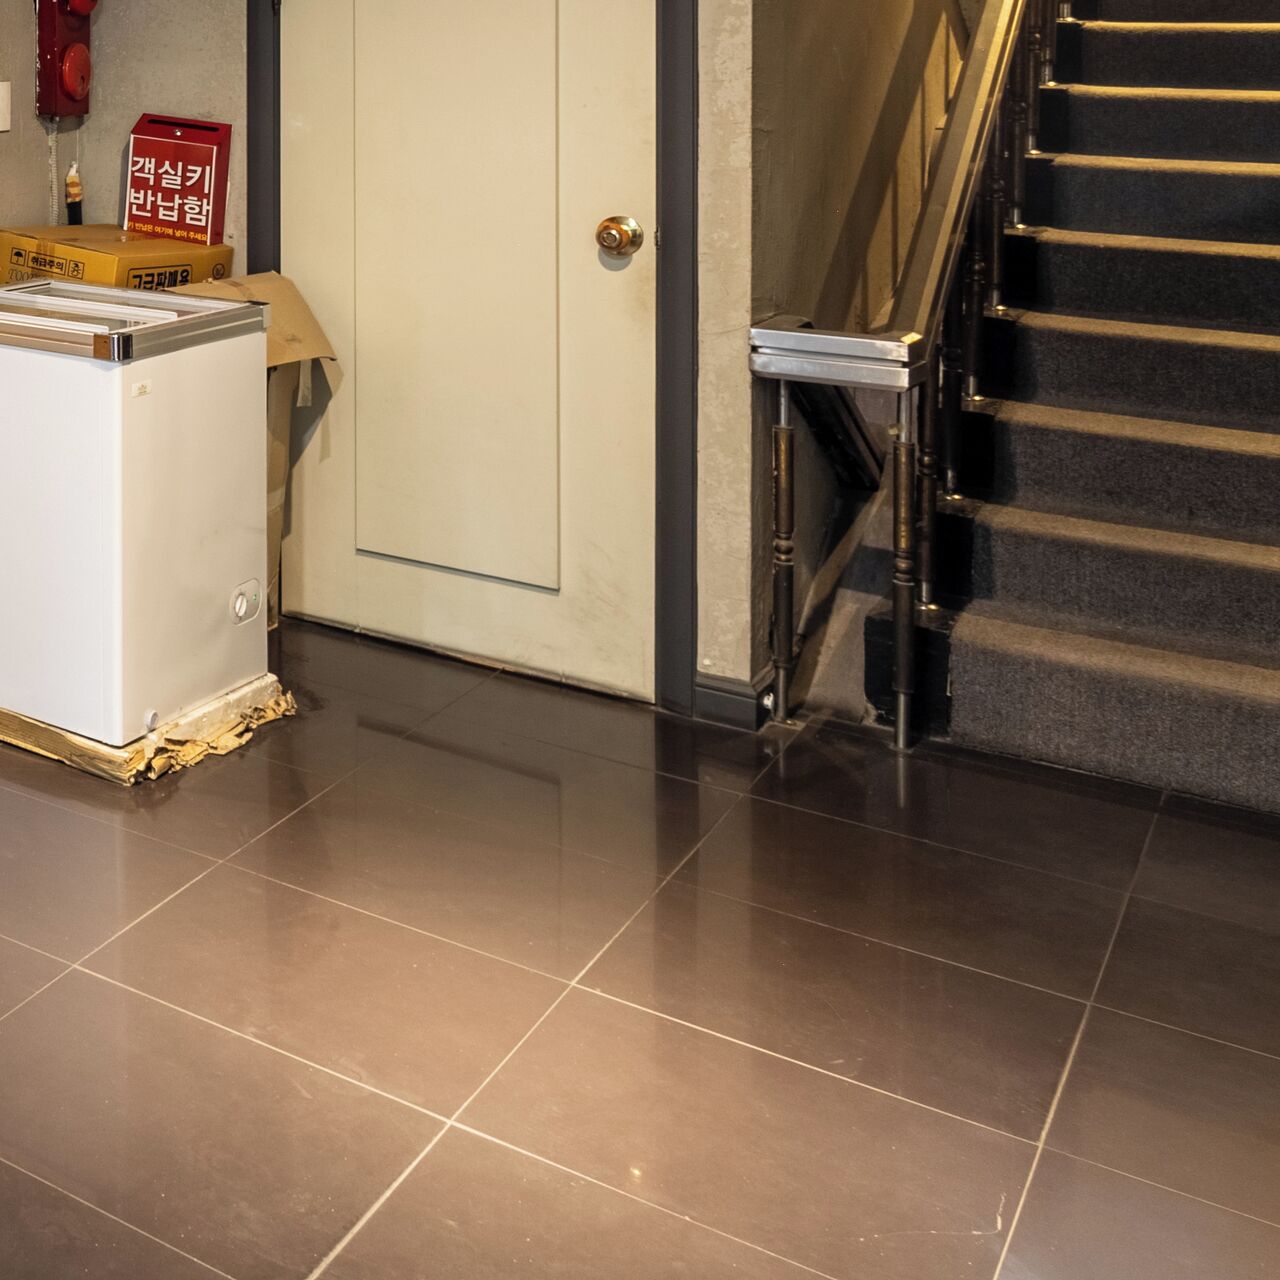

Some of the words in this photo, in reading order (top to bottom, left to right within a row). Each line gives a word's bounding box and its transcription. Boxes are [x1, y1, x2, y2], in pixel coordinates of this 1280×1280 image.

[131, 155, 211, 194] 객실키
[130, 188, 211, 228] 반납함
[31, 255, 64, 272] 취급주의
